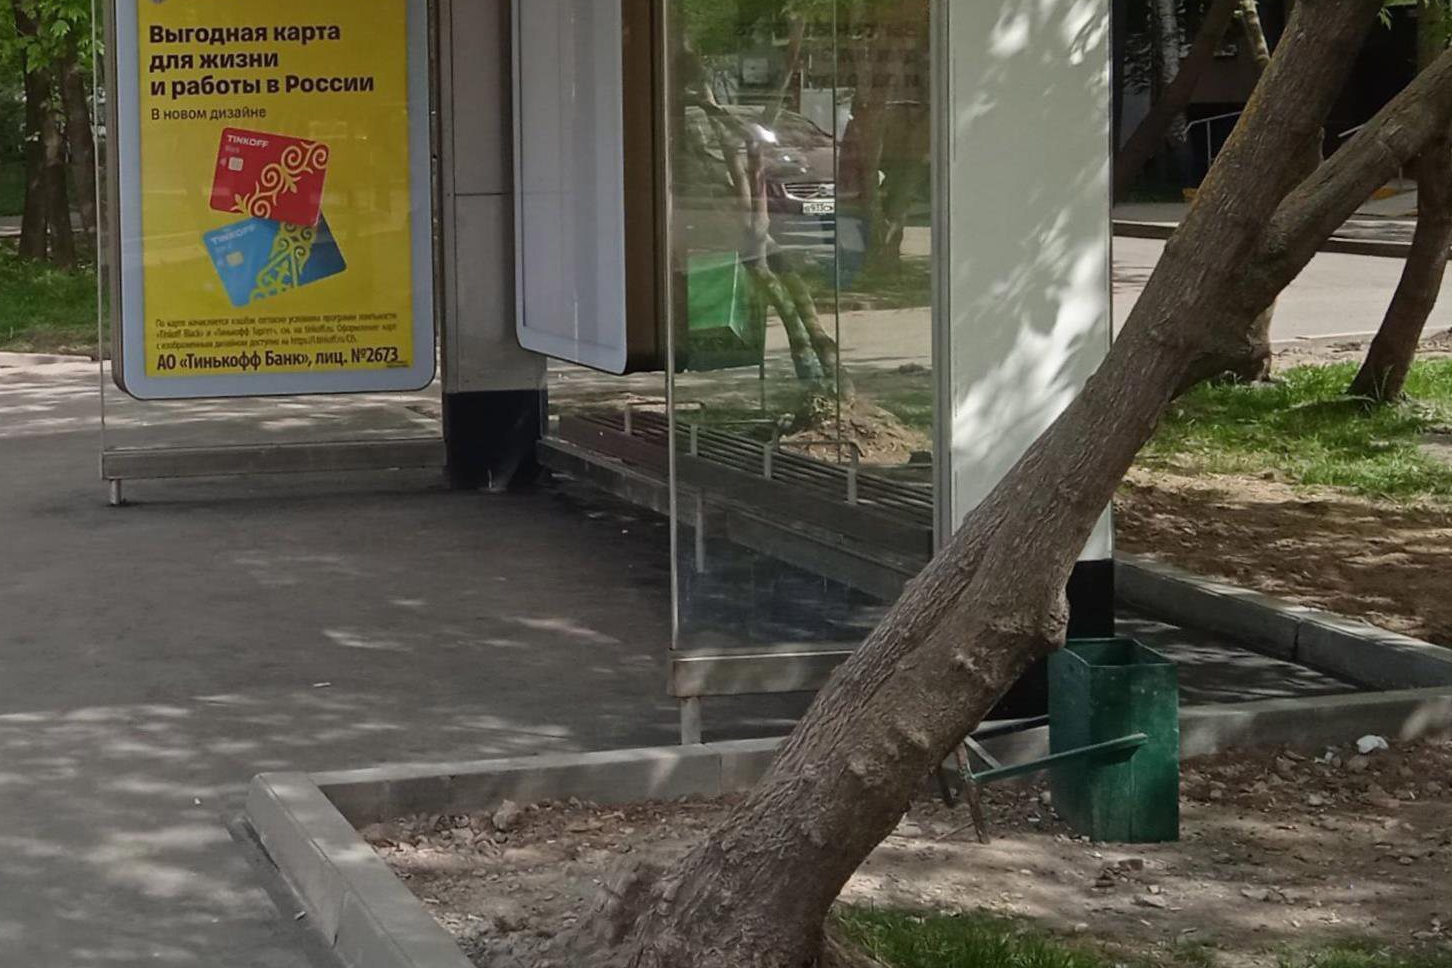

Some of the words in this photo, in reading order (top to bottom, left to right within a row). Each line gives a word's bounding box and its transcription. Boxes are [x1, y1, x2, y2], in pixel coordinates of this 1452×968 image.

[149, 24, 268, 44] Выгодная
[273, 24, 341, 44] карта
[149, 53, 194, 73] для
[199, 52, 279, 69] жизни
[150, 81, 166, 96] и
[171, 76, 261, 100] работы
[266, 79, 280, 93] в
[285, 74, 374, 93] России
[151, 108, 160, 120] В
[163, 108, 207, 120] новом
[209, 106, 267, 121] дизайне
[227, 134, 269, 148] TINKOFF
[156, 354, 177, 370] АО
[180, 350, 261, 371] «Тинькофф
[315, 348, 348, 365] лиц.
[351, 346, 399, 364] №2673
